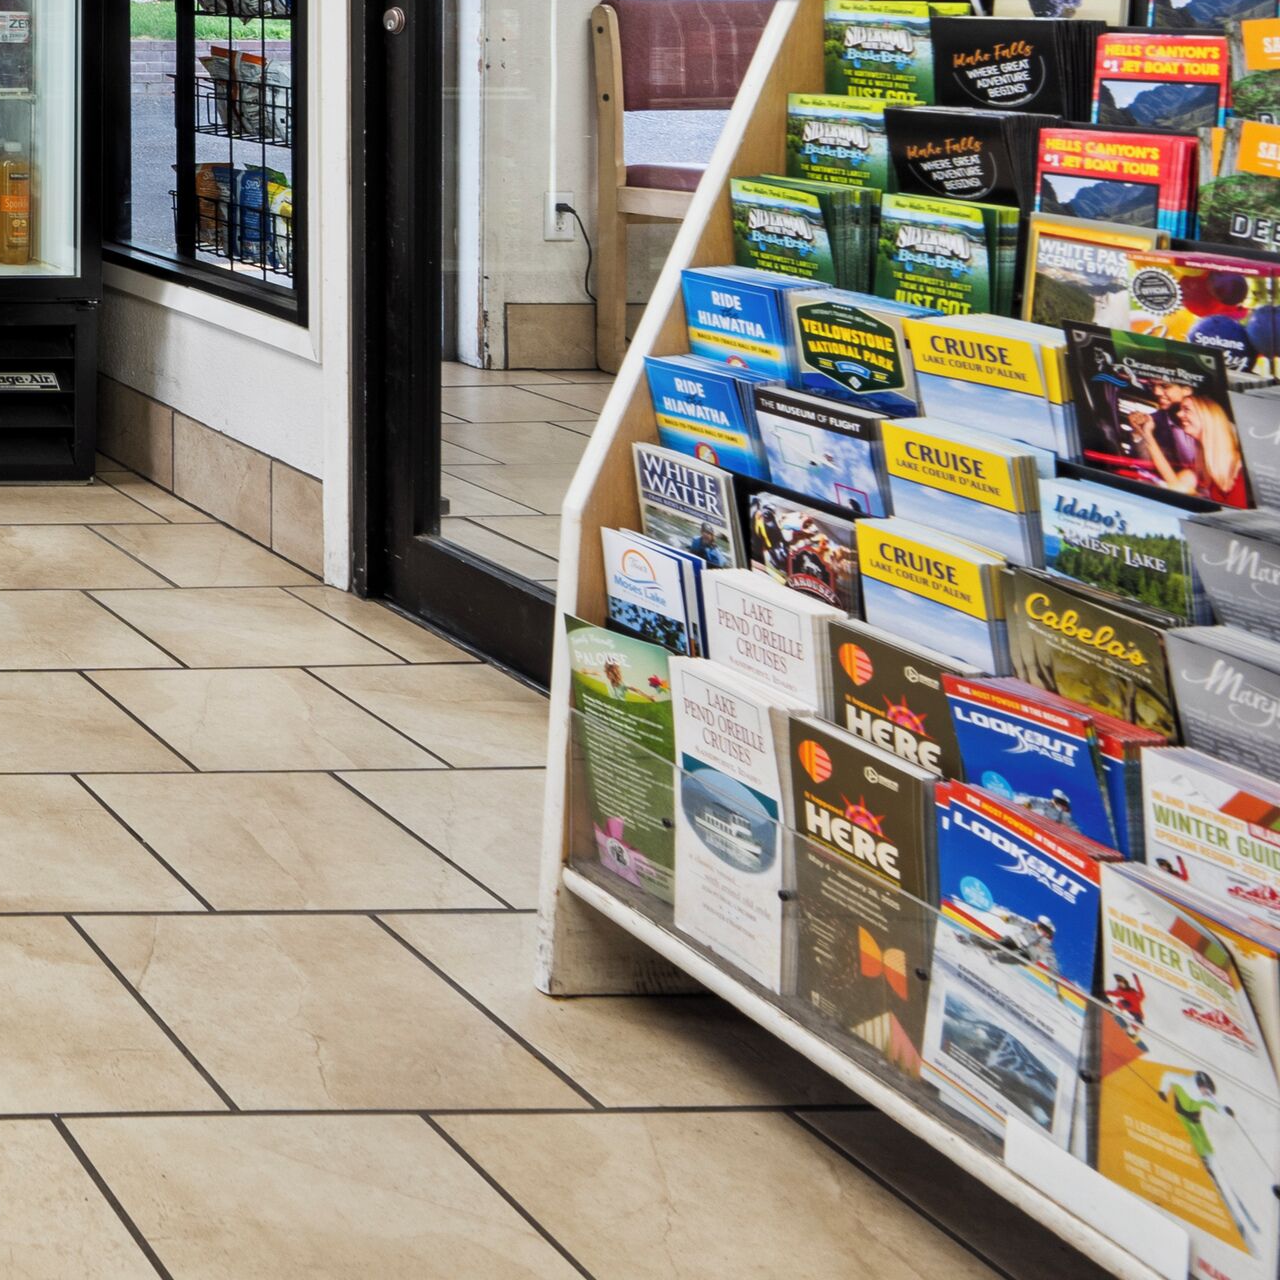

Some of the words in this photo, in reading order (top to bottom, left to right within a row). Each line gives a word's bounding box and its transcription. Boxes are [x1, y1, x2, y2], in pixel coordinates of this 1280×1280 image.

[953, 50, 989, 68] Idaho
[993, 40, 1034, 58] Falls
[1105, 44, 1141, 57] HELLS
[1146, 45, 1219, 59] CANYON'S
[966, 67, 1000, 79] WHERE
[1001, 59, 1029, 71] GREAT
[976, 71, 1031, 89] ADVENTURE
[1104, 60, 1119, 72] #1
[1120, 61, 1143, 72] JET
[1146, 61, 1181, 74] BOAT
[1184, 62, 1219, 76] TOUR
[987, 85, 1027, 98] BEGINS!
[906, 144, 940, 160] Idaho
[944, 137, 983, 152] Falls
[1046, 139, 1081, 152] HELLS
[1085, 143, 1159, 160] CANYON'S
[921, 161, 952, 172] WHERE
[955, 155, 981, 167] GREAT
[932, 166, 983, 181] ADVENTURE
[1044, 154, 1059, 166] #1
[1061, 155, 1081, 168] JET
[1085, 159, 1120, 172] BOAT
[1123, 161, 1159, 176] TOUR
[944, 179, 981, 191] BEGINS!
[1038, 252, 1086, 270] SCENIC
[1088, 263, 1129, 278] BYWA
[1040, 238, 1095, 260] WHITE
[1096, 248, 1128, 265] PAS
[711, 291, 742, 311] RIDE
[895, 290, 933, 308] JUST
[937, 298, 972, 315] GOT
[697, 310, 766, 339] HIAWATHA
[802, 318, 894, 352] YELLOWSTONE
[931, 335, 1012, 366] CRUISE
[1194, 332, 1244, 350] Spokane
[808, 341, 861, 358] NATIONAL
[864, 353, 894, 371] PARK
[922, 353, 946, 366] LAKE
[948, 359, 983, 372] COEUR
[985, 364, 1028, 381] D'ALENE
[675, 378, 706, 398] RIDE
[662, 397, 730, 426] HIAWATHA
[761, 399, 774, 409] THE
[777, 403, 815, 420] MUSEUM
[817, 413, 826, 422] OF
[829, 414, 860, 432] FLIGHT
[641, 451, 716, 497] WHITE
[905, 441, 986, 480] CRUISE
[896, 458, 919, 472] LAKE
[921, 465, 957, 483] COEUR
[959, 475, 1001, 496] D'ALENE
[643, 470, 722, 517] WATER
[1054, 495, 1127, 533] Idaho's
[880, 542, 958, 586] CRUISE
[1124, 545, 1167, 573] LAKE
[614, 575, 642, 595] Moses
[643, 588, 667, 607] Lake
[870, 559, 892, 575] LAKE
[896, 568, 930, 587] COEUR
[932, 582, 972, 604] D'ALENE
[741, 599, 774, 627] LAKE
[717, 608, 750, 641] PEND
[752, 624, 804, 661] OREILLE
[1024, 592, 1148, 667] Cabela's
[575, 649, 630, 668] PALOUSE
[736, 637, 788, 674] CRUISES
[706, 689, 737, 718] LAKE
[683, 697, 715, 726] PEND
[718, 714, 765, 754] OREILLE
[953, 706, 1079, 757] LOOKOUT
[703, 728, 752, 766] CRUISES
[846, 703, 944, 778] HERE
[1029, 746, 1076, 767] PASS
[805, 800, 901, 880] HERE
[1152, 803, 1230, 850] WINTER
[1237, 835, 1280, 873] GUID
[954, 811, 1088, 896] LOOKOUT
[1029, 868, 1076, 904] PASS
[1109, 918, 1183, 972] WINTER
